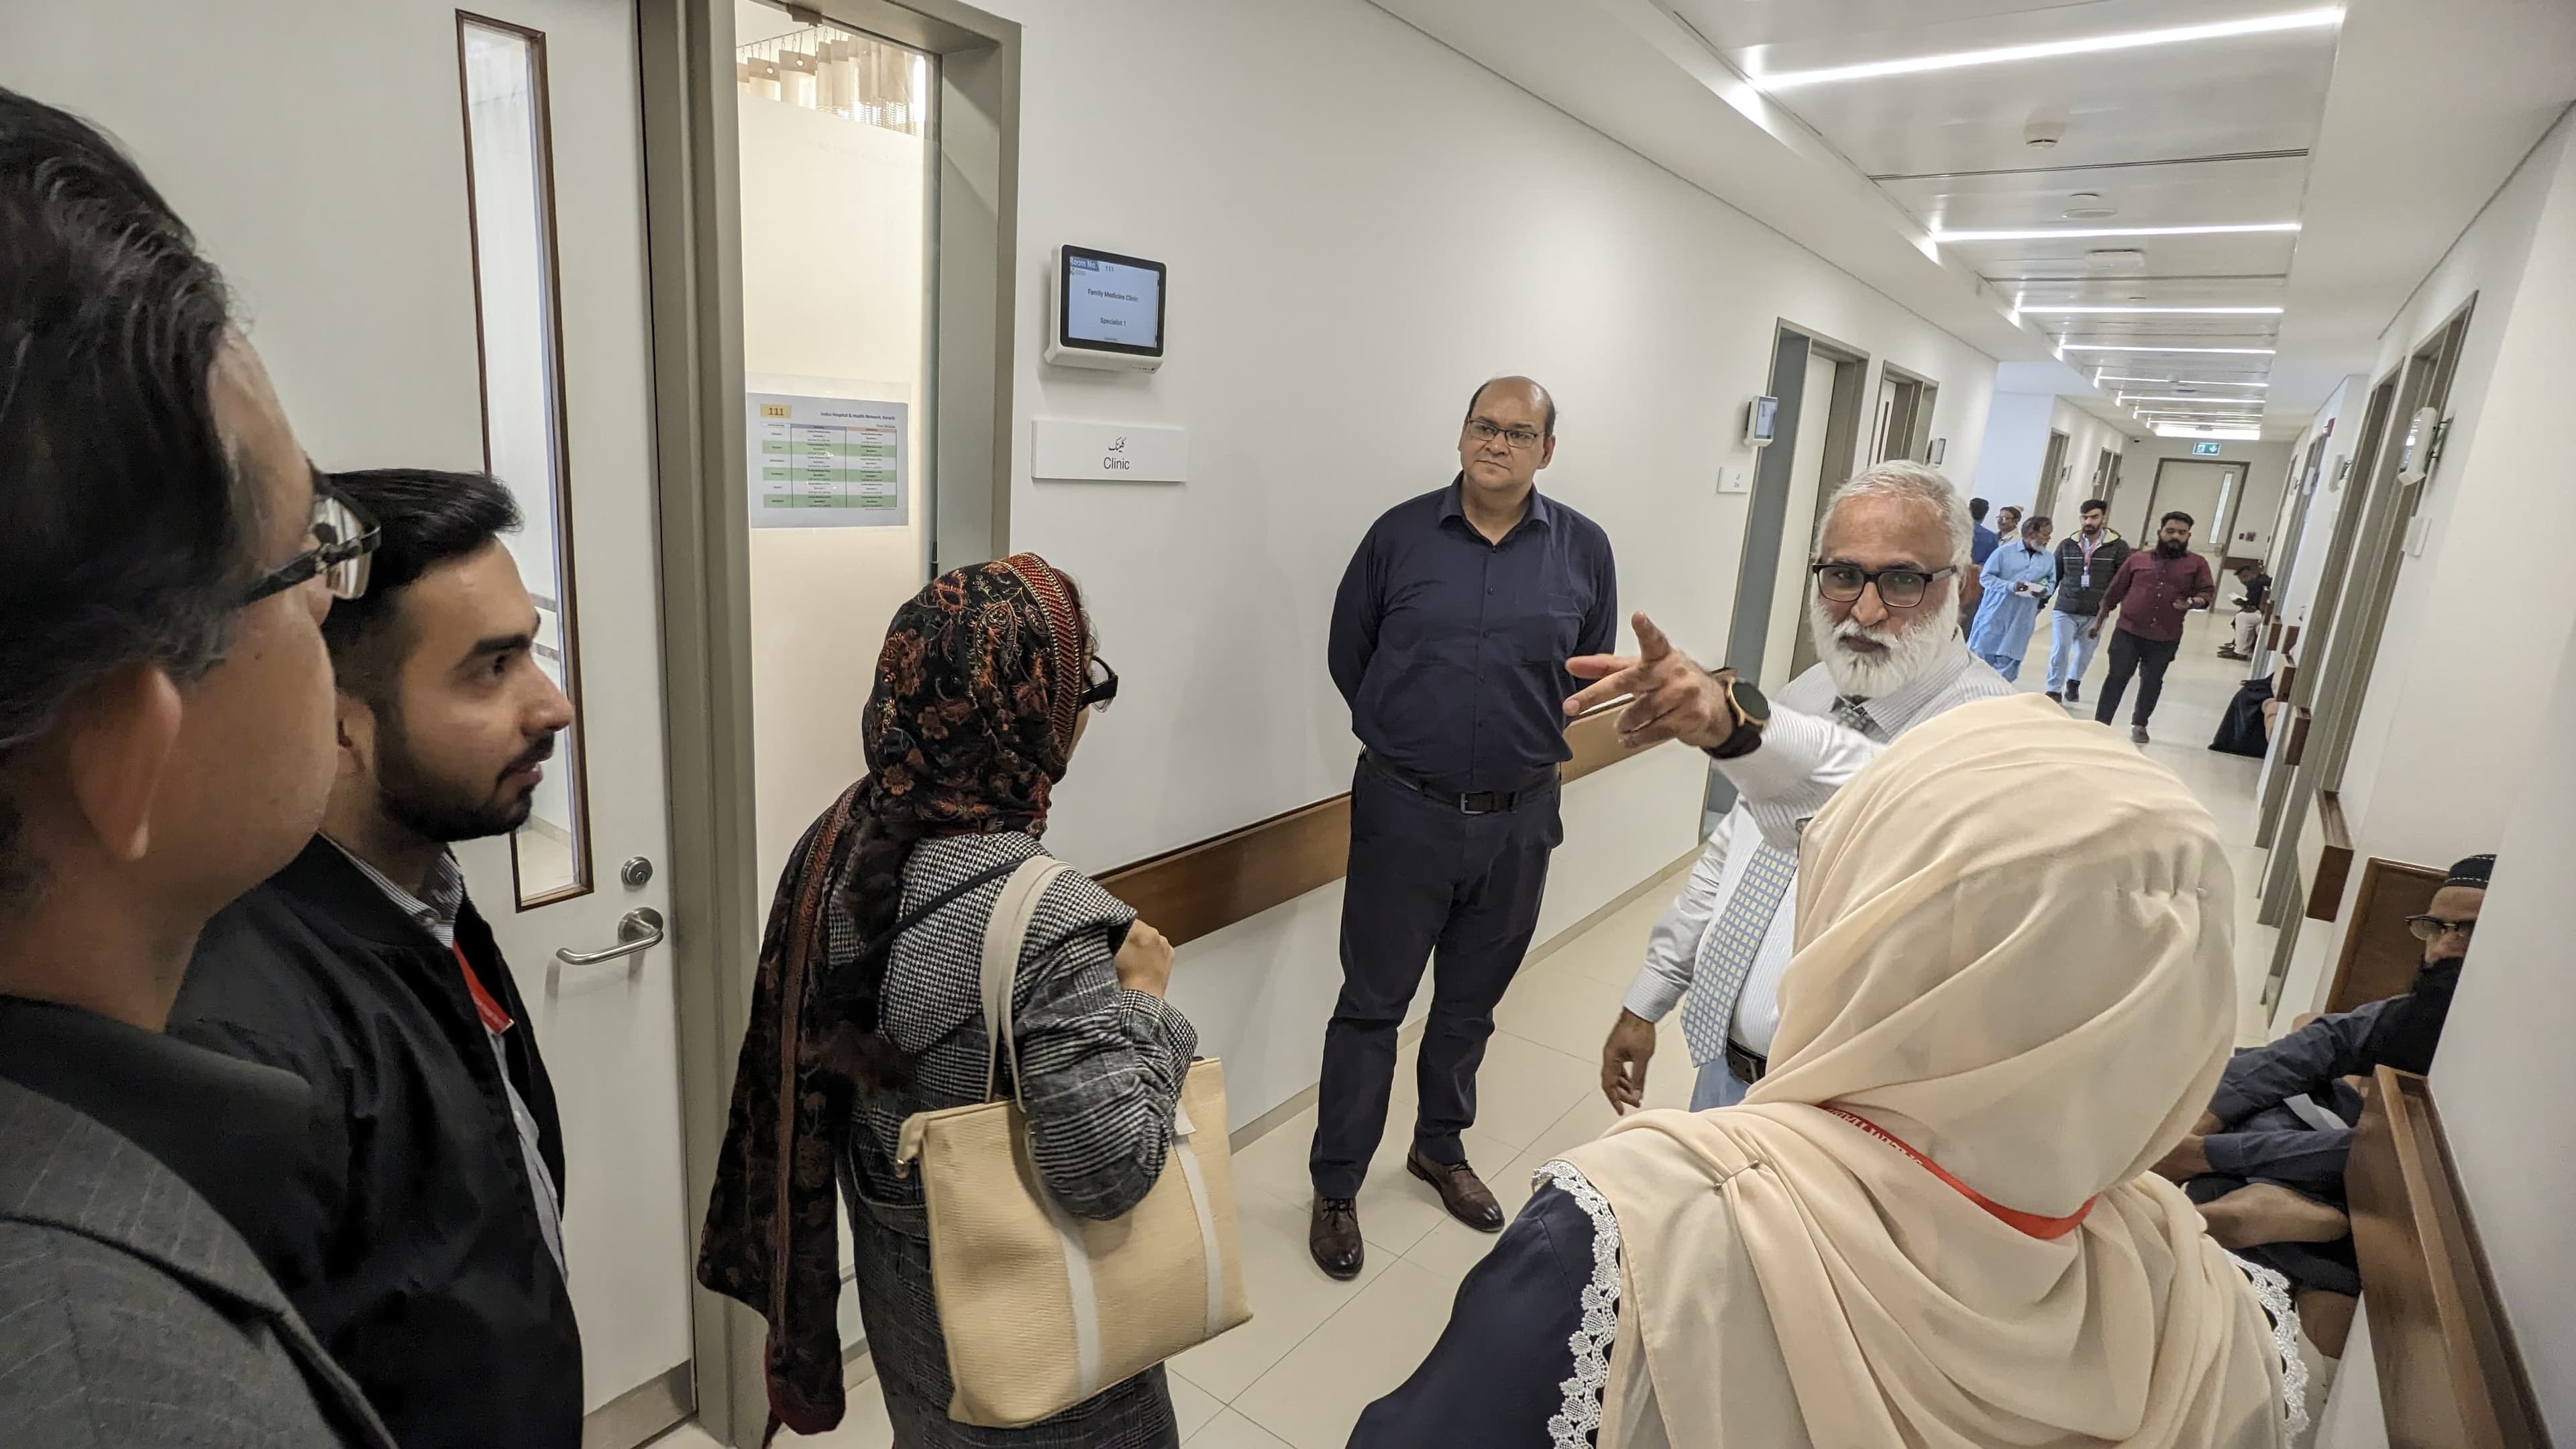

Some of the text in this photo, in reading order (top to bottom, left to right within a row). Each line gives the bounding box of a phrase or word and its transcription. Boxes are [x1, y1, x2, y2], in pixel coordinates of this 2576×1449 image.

[1070, 258, 1086, 267] Room
[1087, 288, 1104, 299] Family
[1104, 290, 1125, 301] Medicine
[1100, 317, 1123, 327] Specialist
[769, 407, 784, 416] 111
[1108, 436, 1127, 453] کلینک
[1104, 457, 1130, 470] Clinic
